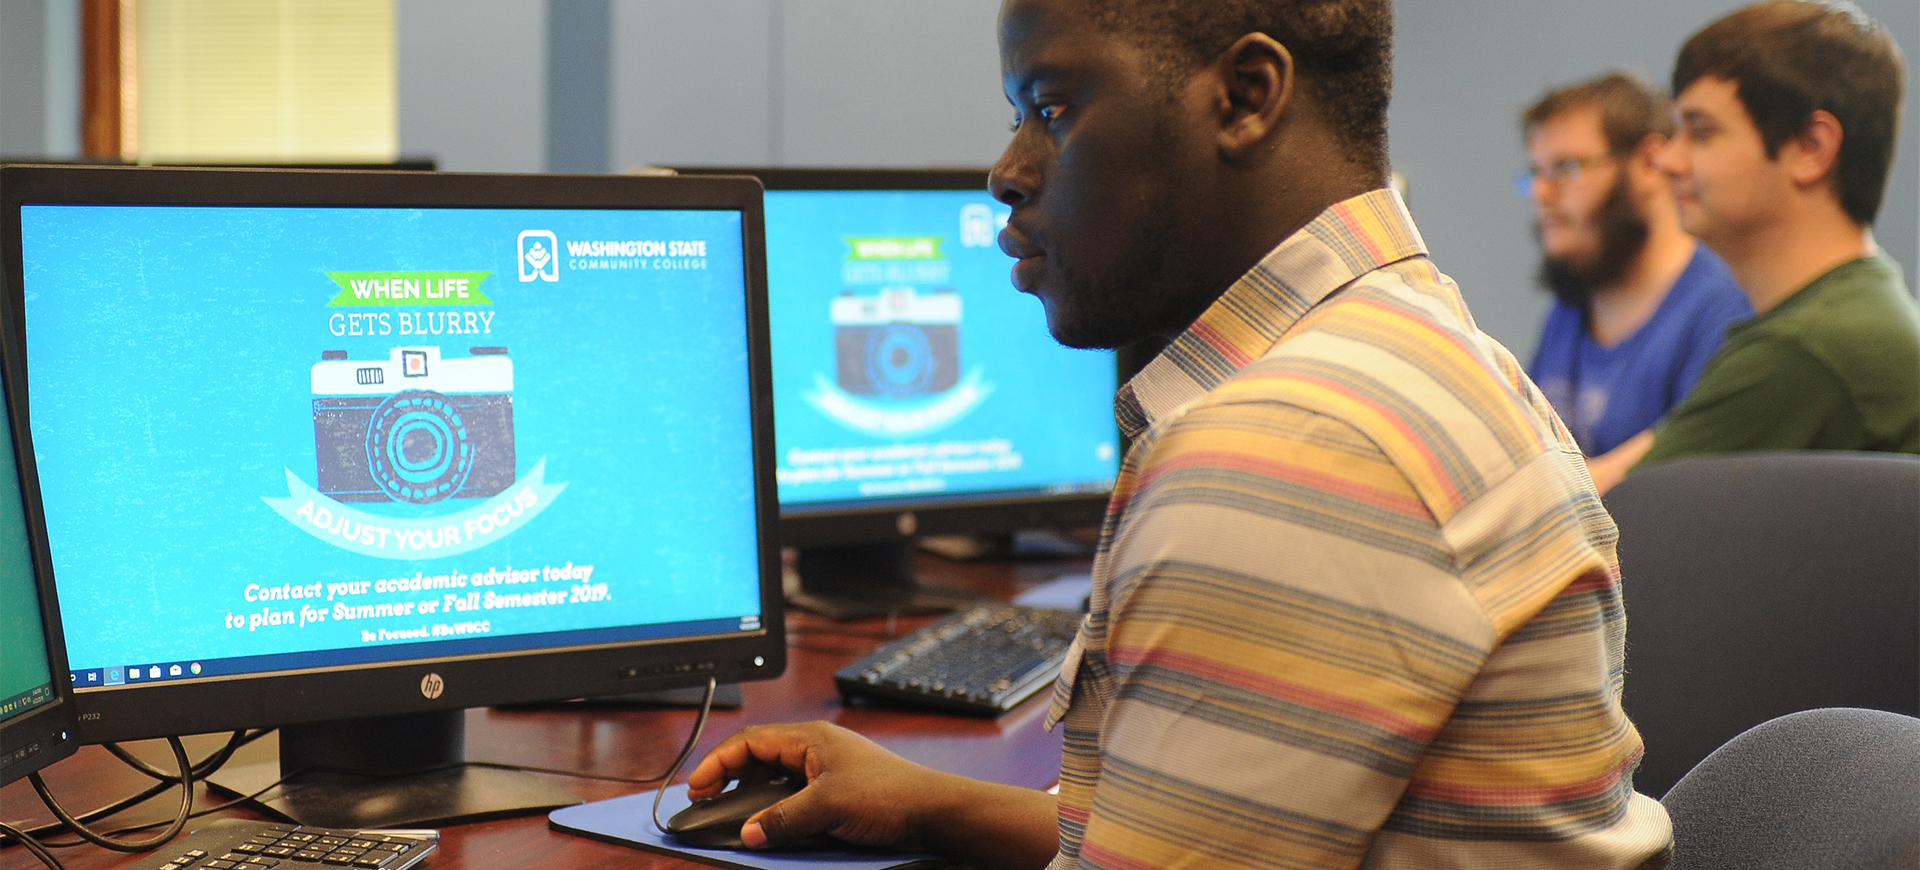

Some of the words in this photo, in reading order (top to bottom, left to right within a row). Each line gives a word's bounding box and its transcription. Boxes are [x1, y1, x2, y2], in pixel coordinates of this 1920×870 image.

[566, 240, 666, 257] WASHINGTON
[668, 240, 706, 257] STATE
[569, 258, 647, 270] COMMUNITY
[653, 258, 706, 270] COLLEGE
[350, 279, 420, 299] WHEN
[426, 279, 470, 298] LIFE
[329, 312, 392, 336] GETS
[398, 311, 495, 335] BLURRY
[295, 500, 391, 548] ADJUST
[394, 525, 461, 550] YOUR
[464, 486, 538, 540] FOCUS
[244, 580, 322, 602] Contact
[327, 580, 371, 601] your
[374, 570, 468, 593] academic
[471, 566, 540, 587] advisor
[543, 561, 594, 583] today
[224, 612, 245, 629] to
[249, 607, 295, 632] plan
[299, 604, 329, 628] for
[332, 602, 414, 621] Summer
[418, 600, 439, 615] or
[442, 592, 480, 613] Fall
[483, 589, 568, 610] Semester
[569, 583, 611, 603] 2019.
[361, 630, 376, 642] Be
[378, 625, 430, 640] Focused.
[431, 620, 490, 636] #BeWSCC
[422, 673, 442, 699] hp
[82, 712, 101, 721] P232
